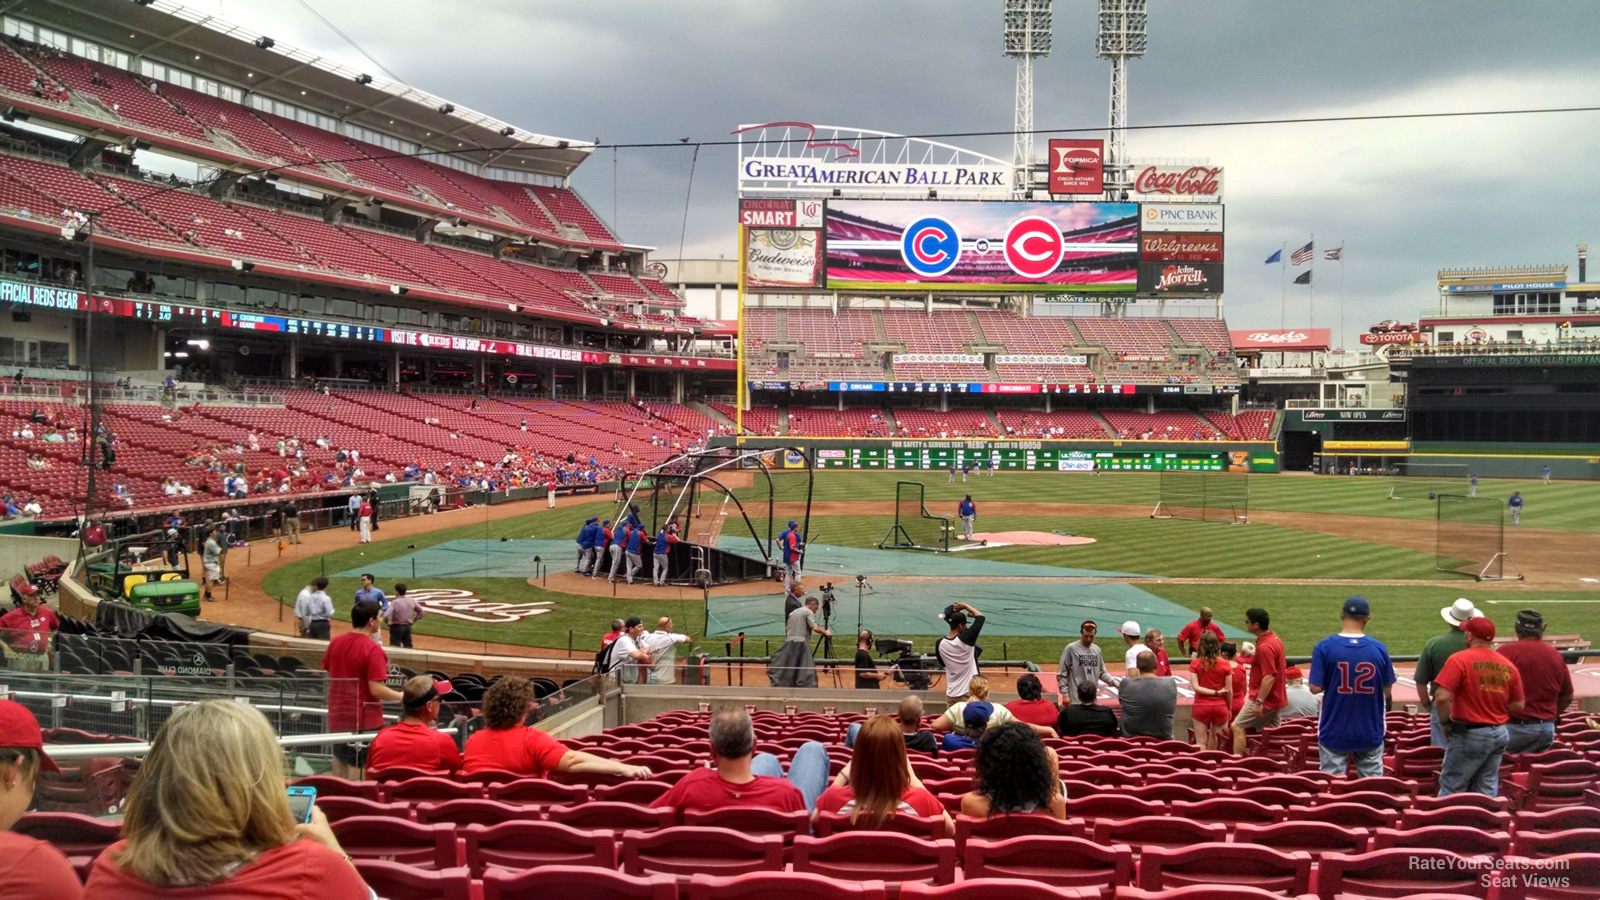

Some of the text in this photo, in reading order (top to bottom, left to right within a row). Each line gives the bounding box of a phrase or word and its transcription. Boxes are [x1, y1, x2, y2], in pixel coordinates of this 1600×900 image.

[745, 160, 1006, 185] GREAT AMERICAN BALL PARK
[1135, 166, 1224, 195] Coca-Cola
[743, 200, 793, 209] CINCINNATI
[743, 210, 794, 225] SMART
[1160, 209, 1217, 220] PNC BANK
[1144, 238, 1219, 256] Walgreens
[747, 247, 816, 267] Budweiser
[1174, 265, 1195, 275] John
[1155, 270, 1207, 290] Morrell
[33, 287, 55, 307] REDS
[56, 290, 78, 310] GEAR
[160, 305, 171, 313] ERA
[148, 311, 152, 319] 7
[159, 313, 172, 321] 3.47
[391, 330, 405, 344] VISIT
[407, 332, 417, 345] THE
[428, 335, 451, 347] REDS
[452, 337, 466, 350] TEAM
[467, 339, 480, 351] SHOP
[1246, 331, 1308, 342] Reds
[1379, 333, 1414, 342] TOYOTA
[1463, 357, 1496, 366] OFFICIAL
[1524, 357, 1541, 365] FAN
[1542, 356, 1564, 364] CLUB
[1566, 356, 1583, 364] FOR
[1340, 411, 1367, 419] NOW OPEN
[892, 441, 902, 449] FOR
[903, 441, 922, 449] SAFETY
[928, 441, 950, 449] SERVICE
[951, 441, 964, 449] TEXT
[994, 441, 1009, 449] ISSUE
[1010, 441, 1018, 449] TO
[1019, 441, 1041, 449] 69050
[1078, 659, 1098, 667] POWER
[1337, 661, 1376, 694] 12
